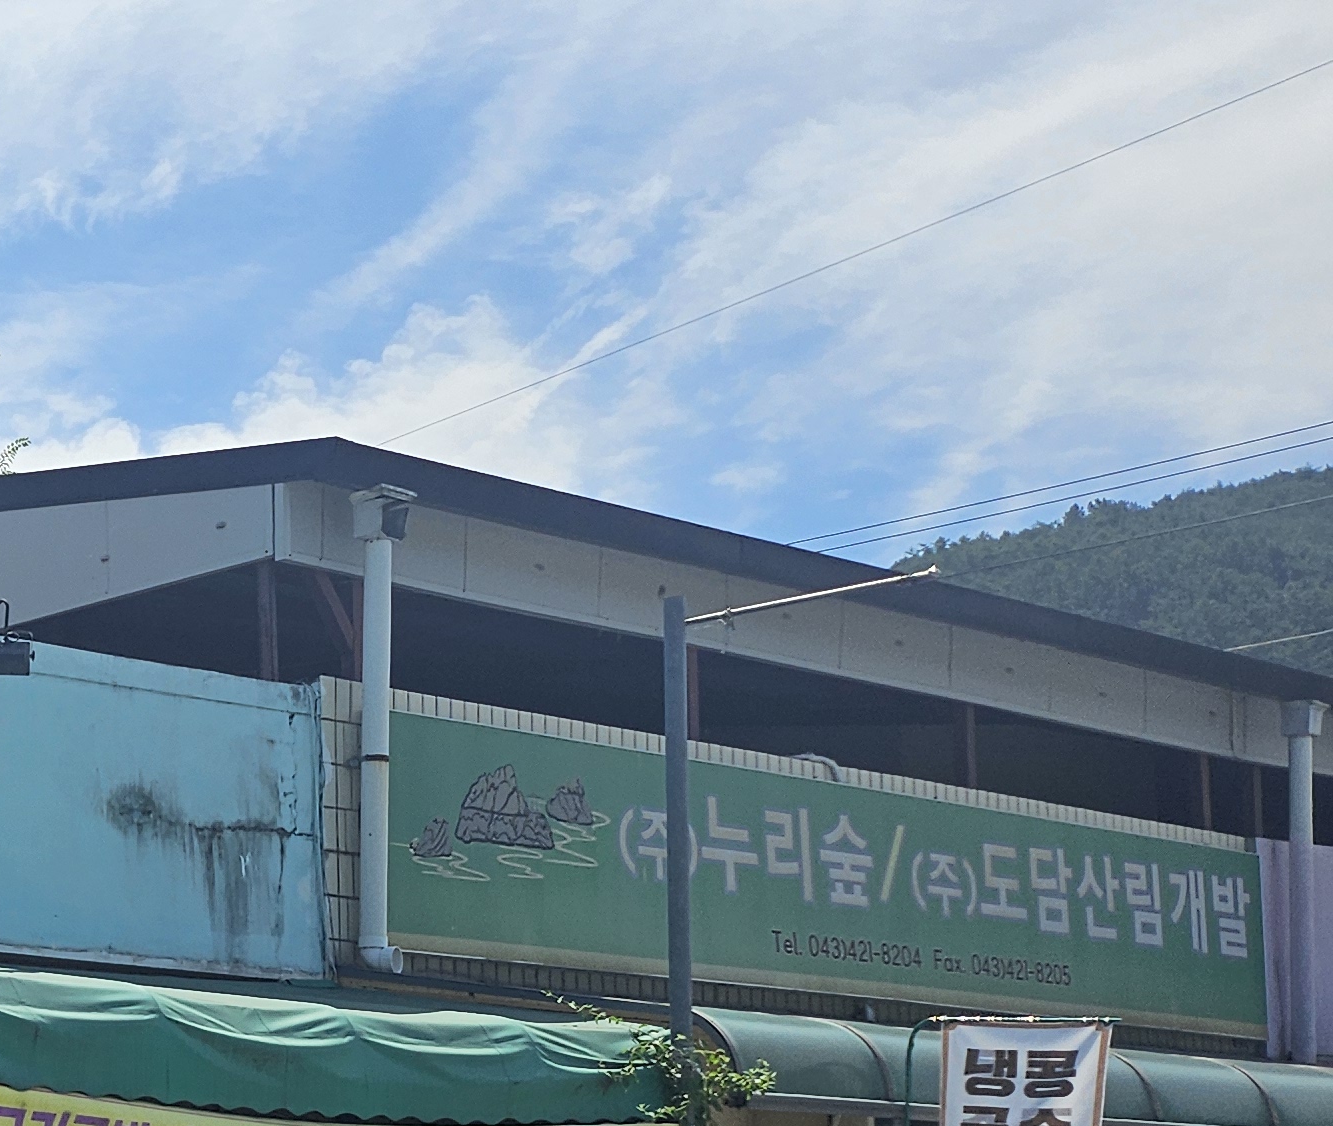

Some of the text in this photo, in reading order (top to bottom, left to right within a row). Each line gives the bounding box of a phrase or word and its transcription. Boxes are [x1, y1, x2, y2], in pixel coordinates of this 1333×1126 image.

[772, 931, 1073, 987] Tel. 043)421-8204 Fax. 043)421-8205
[964, 1048, 1079, 1098] 냉콩
